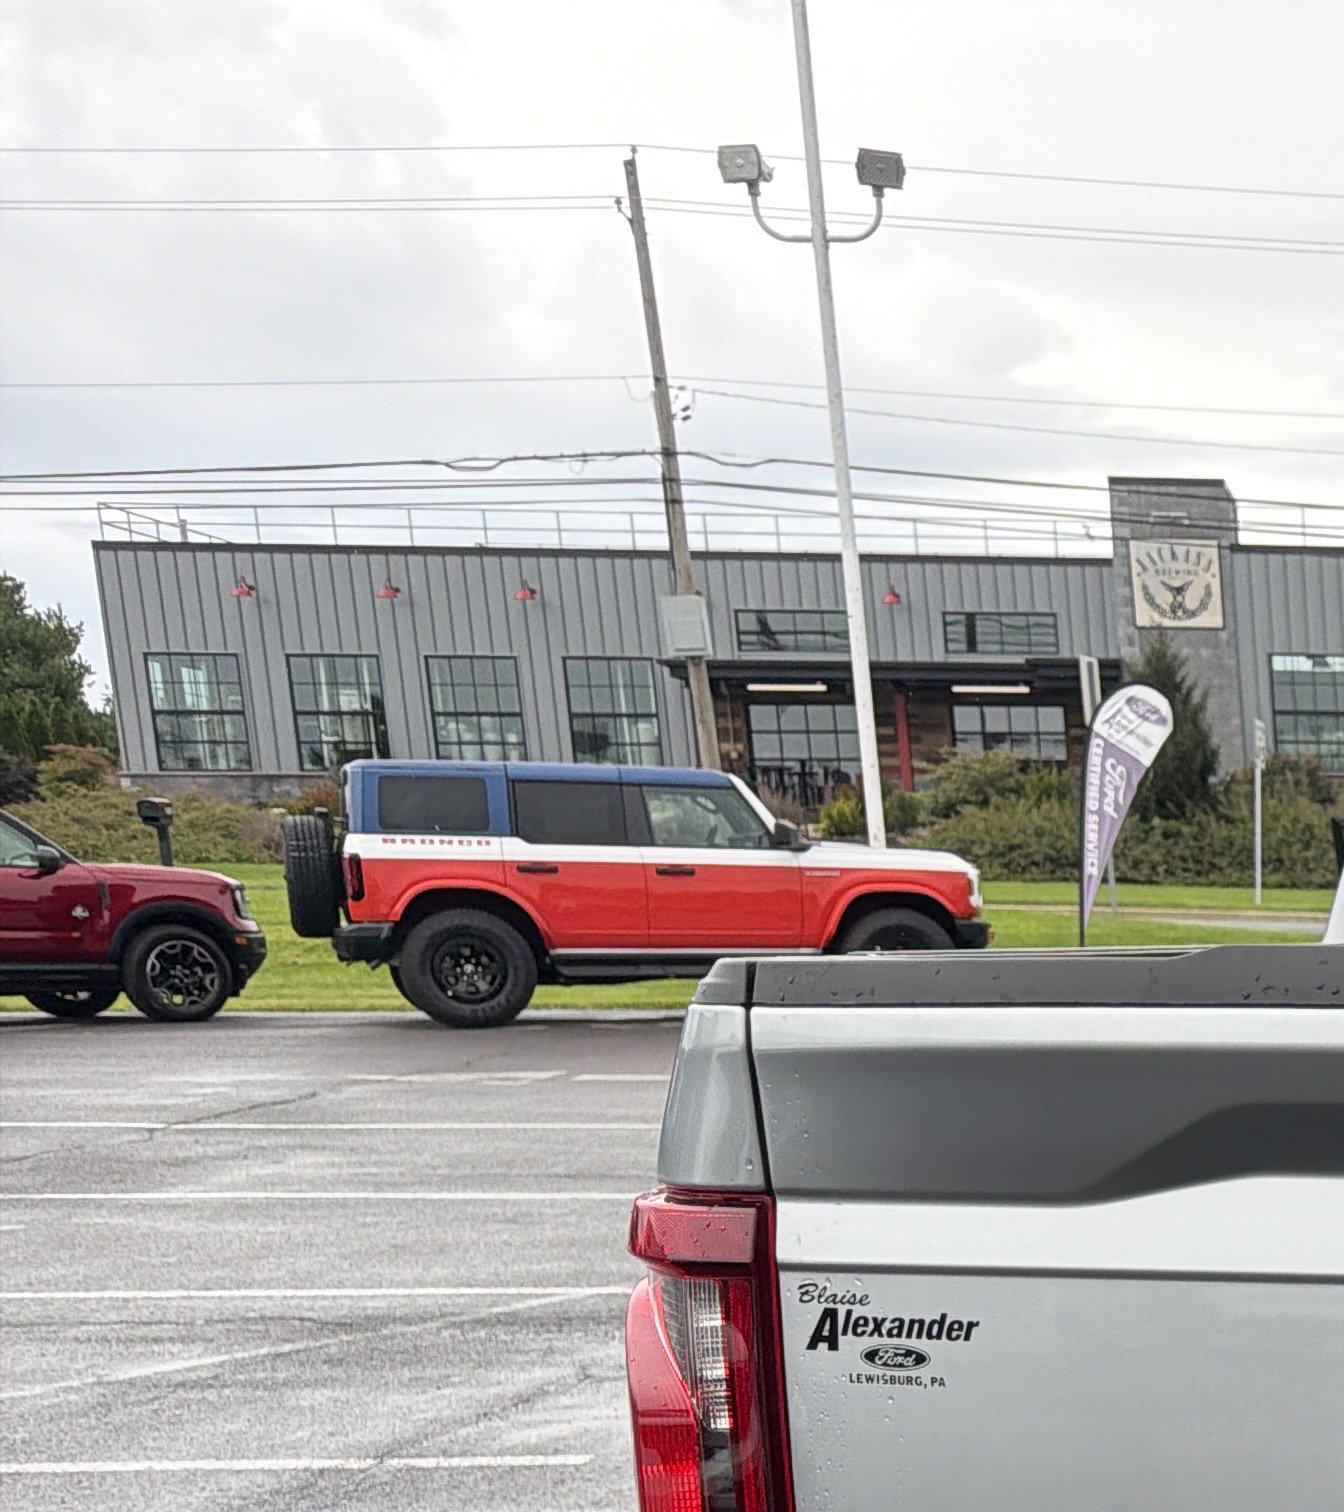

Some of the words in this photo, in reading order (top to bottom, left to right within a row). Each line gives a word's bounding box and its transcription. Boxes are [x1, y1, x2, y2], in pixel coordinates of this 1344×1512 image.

[1085, 737, 1105, 812] CERTIFIED
[1103, 757, 1127, 819] Ford
[1084, 813, 1100, 878] SERVICE
[797, 1282, 871, 1307] Blaise
[805, 1307, 980, 1352] Alexander
[874, 1347, 917, 1367] Ford
[849, 1373, 928, 1389] LEWISBURG,
[931, 1376, 946, 1388] PA
